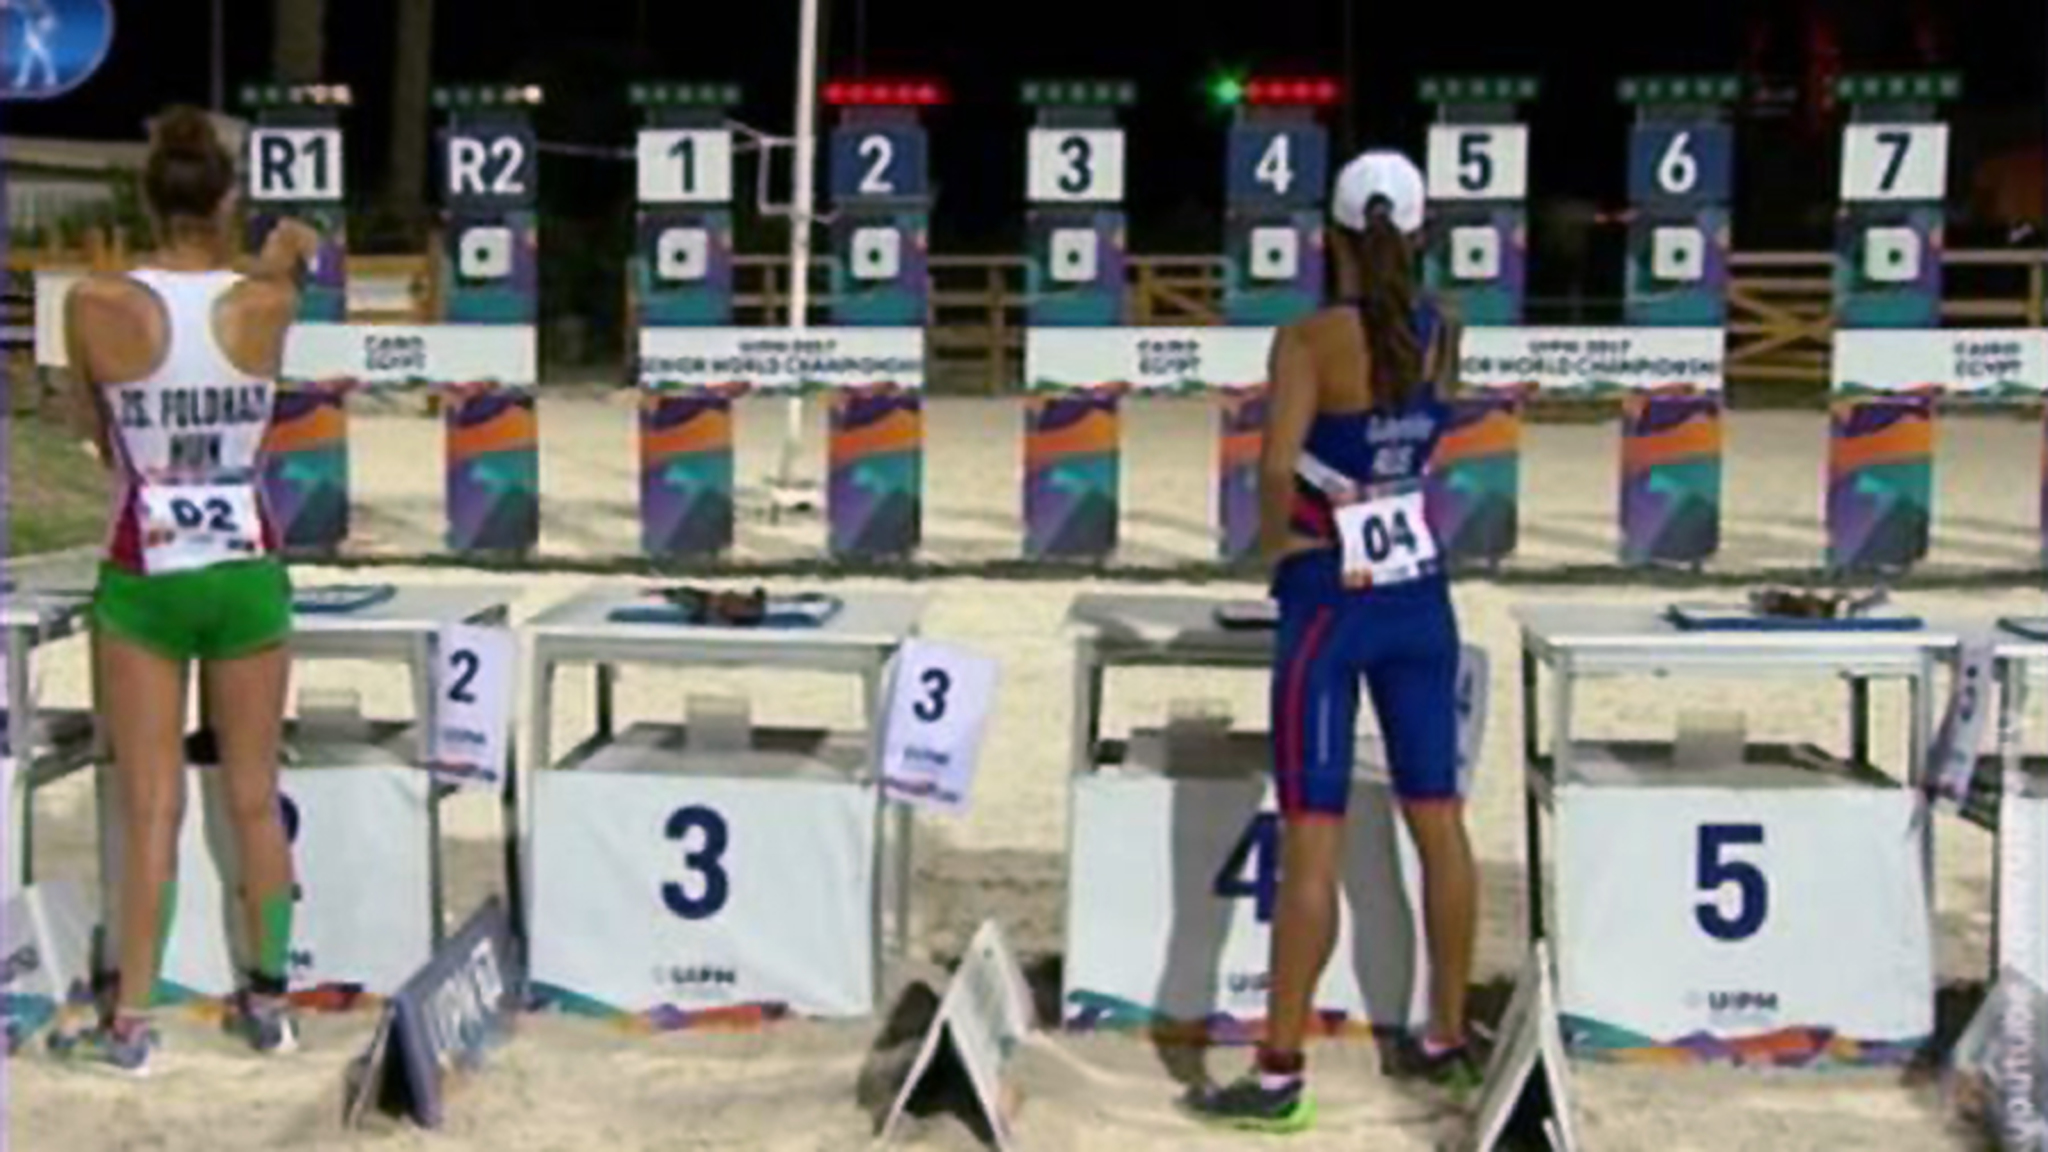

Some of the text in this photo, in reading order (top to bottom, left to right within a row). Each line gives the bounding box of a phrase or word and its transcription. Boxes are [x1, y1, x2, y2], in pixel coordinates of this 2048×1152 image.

[260, 136, 329, 192] R1
[450, 137, 525, 194] R2
[668, 137, 696, 194] 1
[858, 135, 894, 193] 2
[1057, 136, 1092, 194] 3
[1255, 133, 1294, 195] 4
[1457, 133, 1492, 191] 5
[1657, 131, 1698, 194] 6
[1876, 132, 1911, 192] 7
[169, 497, 240, 532] 02
[1362, 510, 1418, 564] 04
[447, 649, 480, 704] 2
[912, 667, 951, 722] 3
[660, 804, 730, 920] 3
[1213, 811, 1279, 923] 4
[1693, 823, 1770, 942] 5
